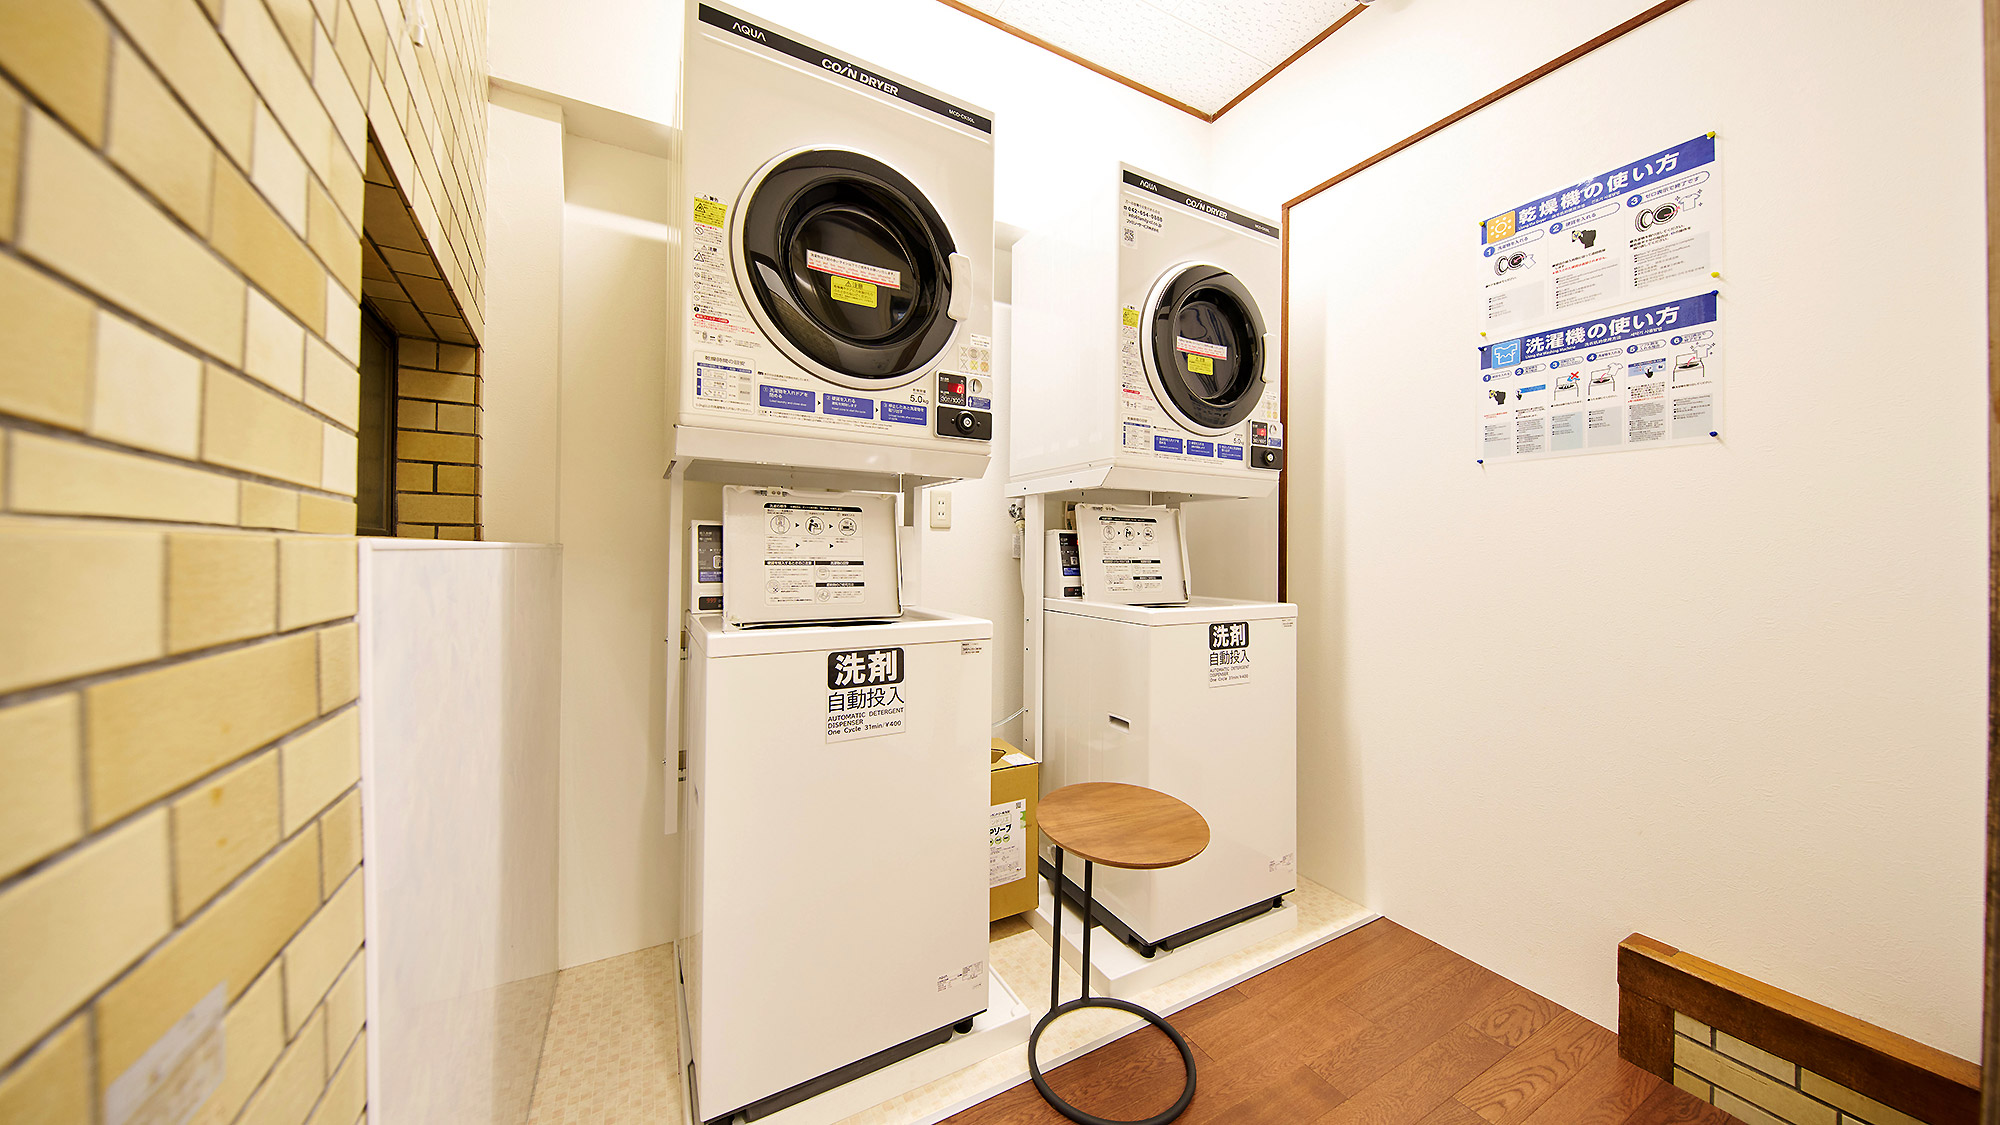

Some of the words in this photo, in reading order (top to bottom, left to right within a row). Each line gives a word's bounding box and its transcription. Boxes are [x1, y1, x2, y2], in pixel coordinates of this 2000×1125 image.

[733, 22, 767, 42] AQUA
[859, 73, 899, 96] DRYER
[1139, 179, 1158, 192] AQUA
[1518, 152, 1680, 225] 乾燥機の使い方
[1206, 205, 1228, 220] DRYER
[1525, 305, 1680, 354] 洗濯機の使い方
[1212, 624, 1246, 648] 洗剤
[1209, 649, 1250, 666] 自動投入
[834, 650, 898, 686] 洗剤
[828, 686, 905, 713] 自動投入
[827, 712, 866, 722] AUTOMATIC
[868, 707, 904, 717] DETERGENT
[827, 718, 864, 729] DISPENSER
[843, 725, 862, 734] Cycle
